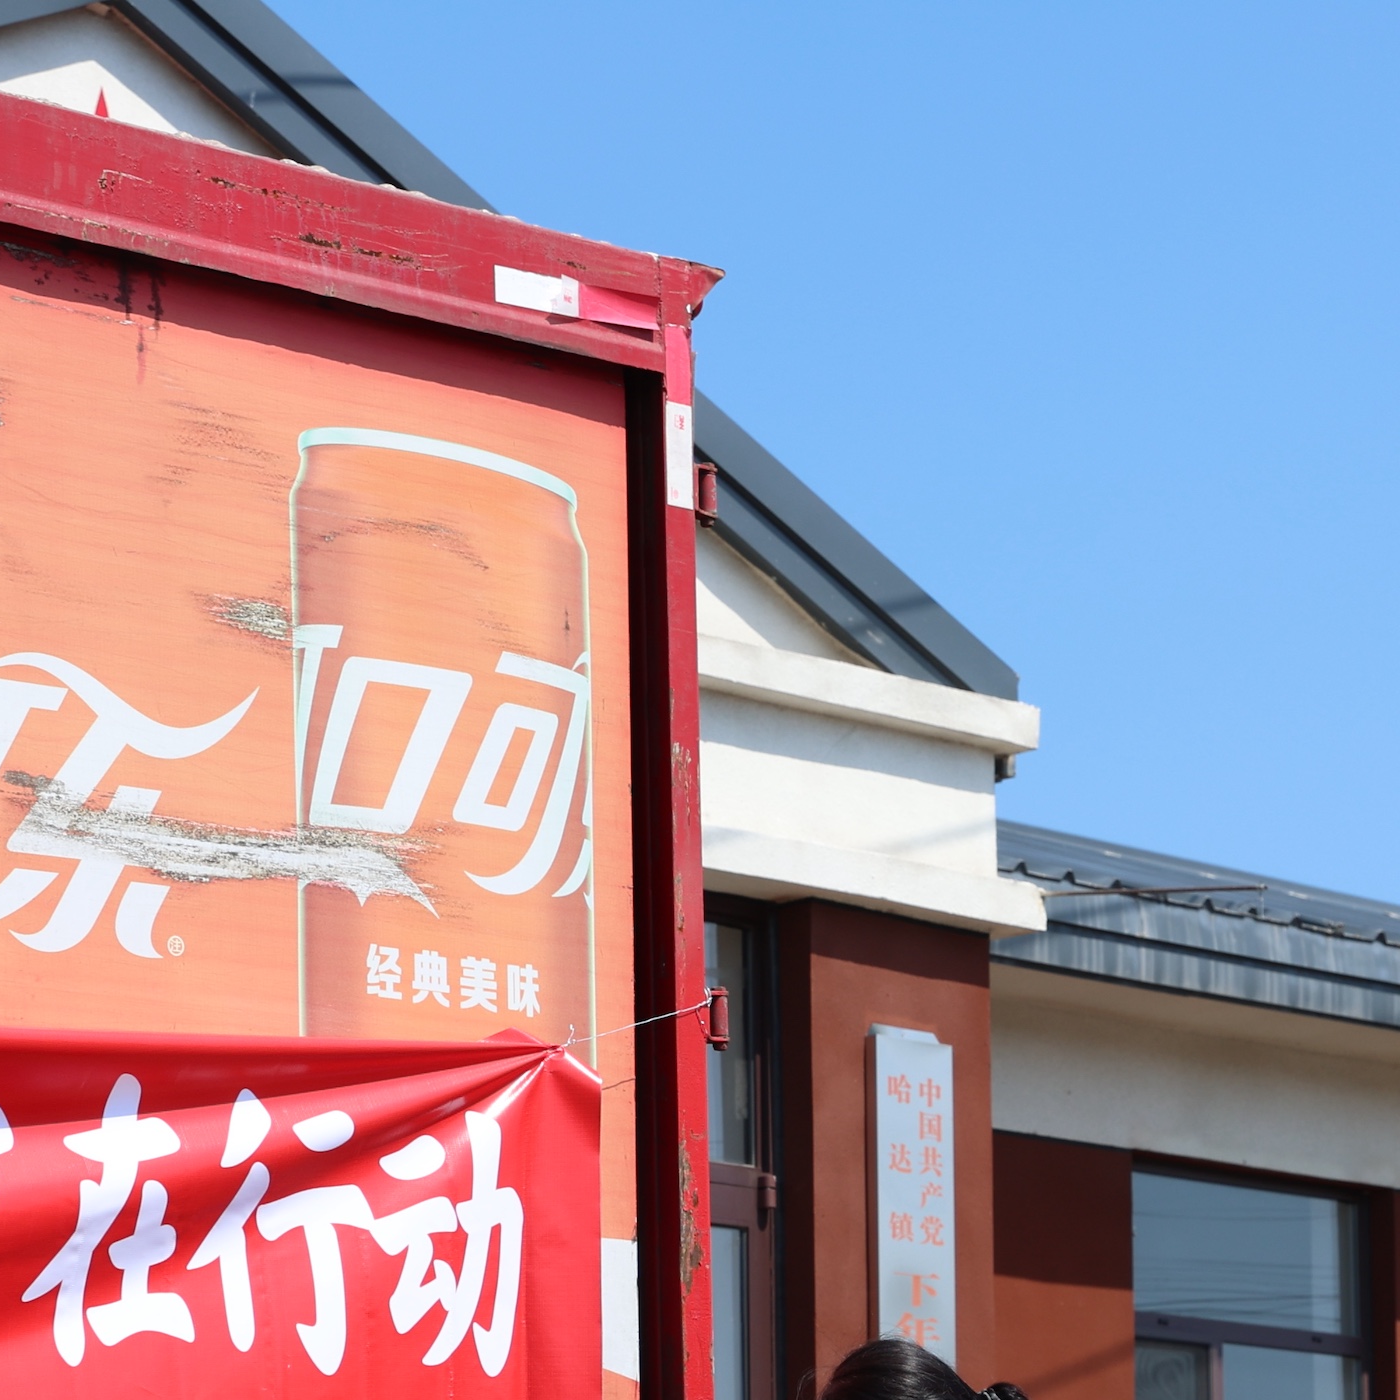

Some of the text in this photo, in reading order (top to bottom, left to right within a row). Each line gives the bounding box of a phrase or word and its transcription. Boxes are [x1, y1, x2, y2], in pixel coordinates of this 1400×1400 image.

[366, 943, 542, 1018] 经典美味
[887, 1074, 915, 1243] 哈达镇
[918, 1078, 945, 1246] 中国共产党
